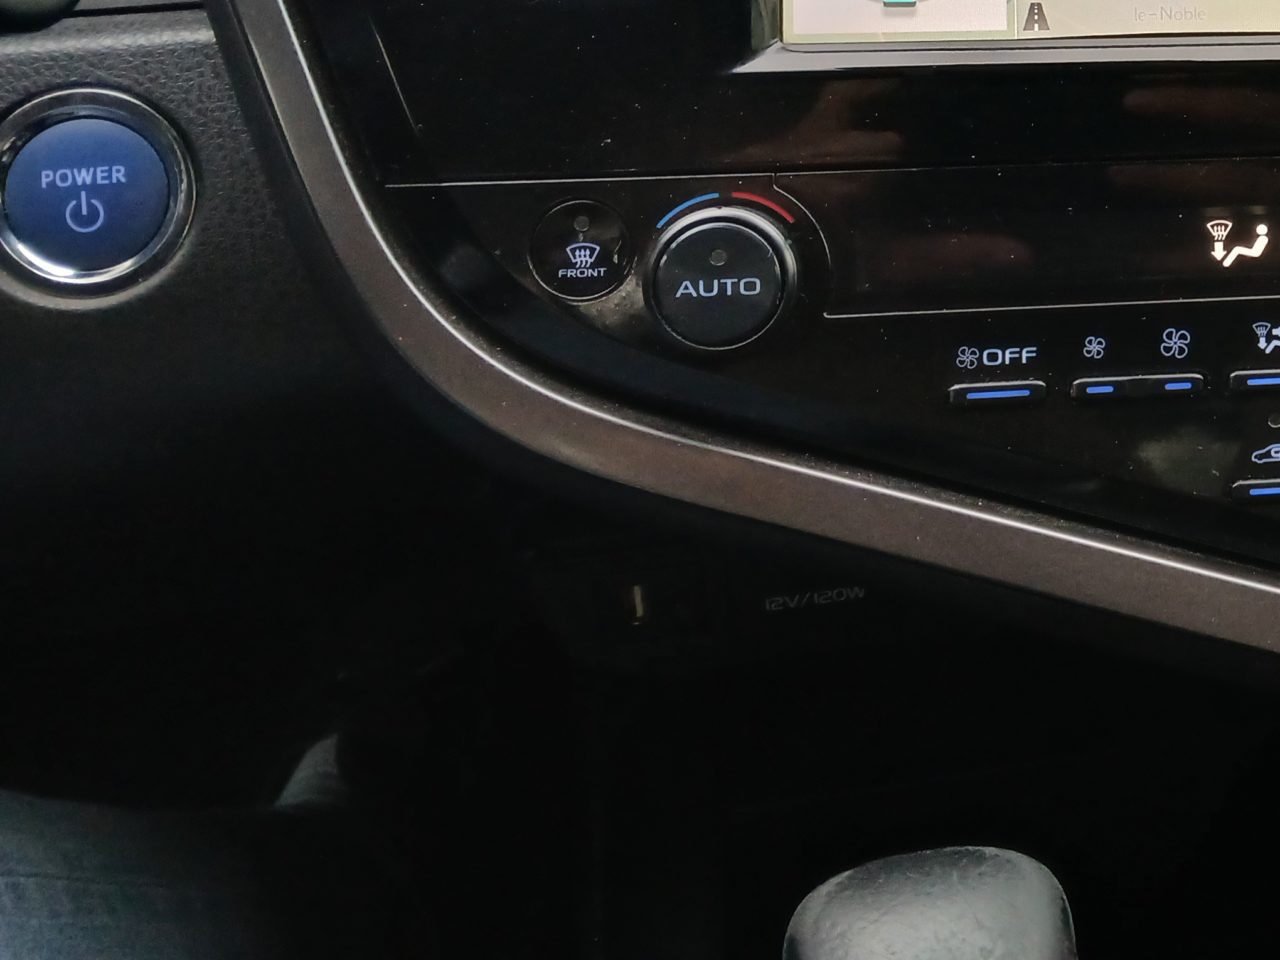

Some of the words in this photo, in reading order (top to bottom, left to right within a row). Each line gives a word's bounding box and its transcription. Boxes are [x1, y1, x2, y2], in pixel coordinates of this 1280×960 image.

[41, 165, 127, 189] POWER
[558, 267, 607, 278] FRONT
[675, 277, 761, 298] AUTO
[983, 346, 1037, 366] OFF
[765, 587, 865, 611] 12V/120W
